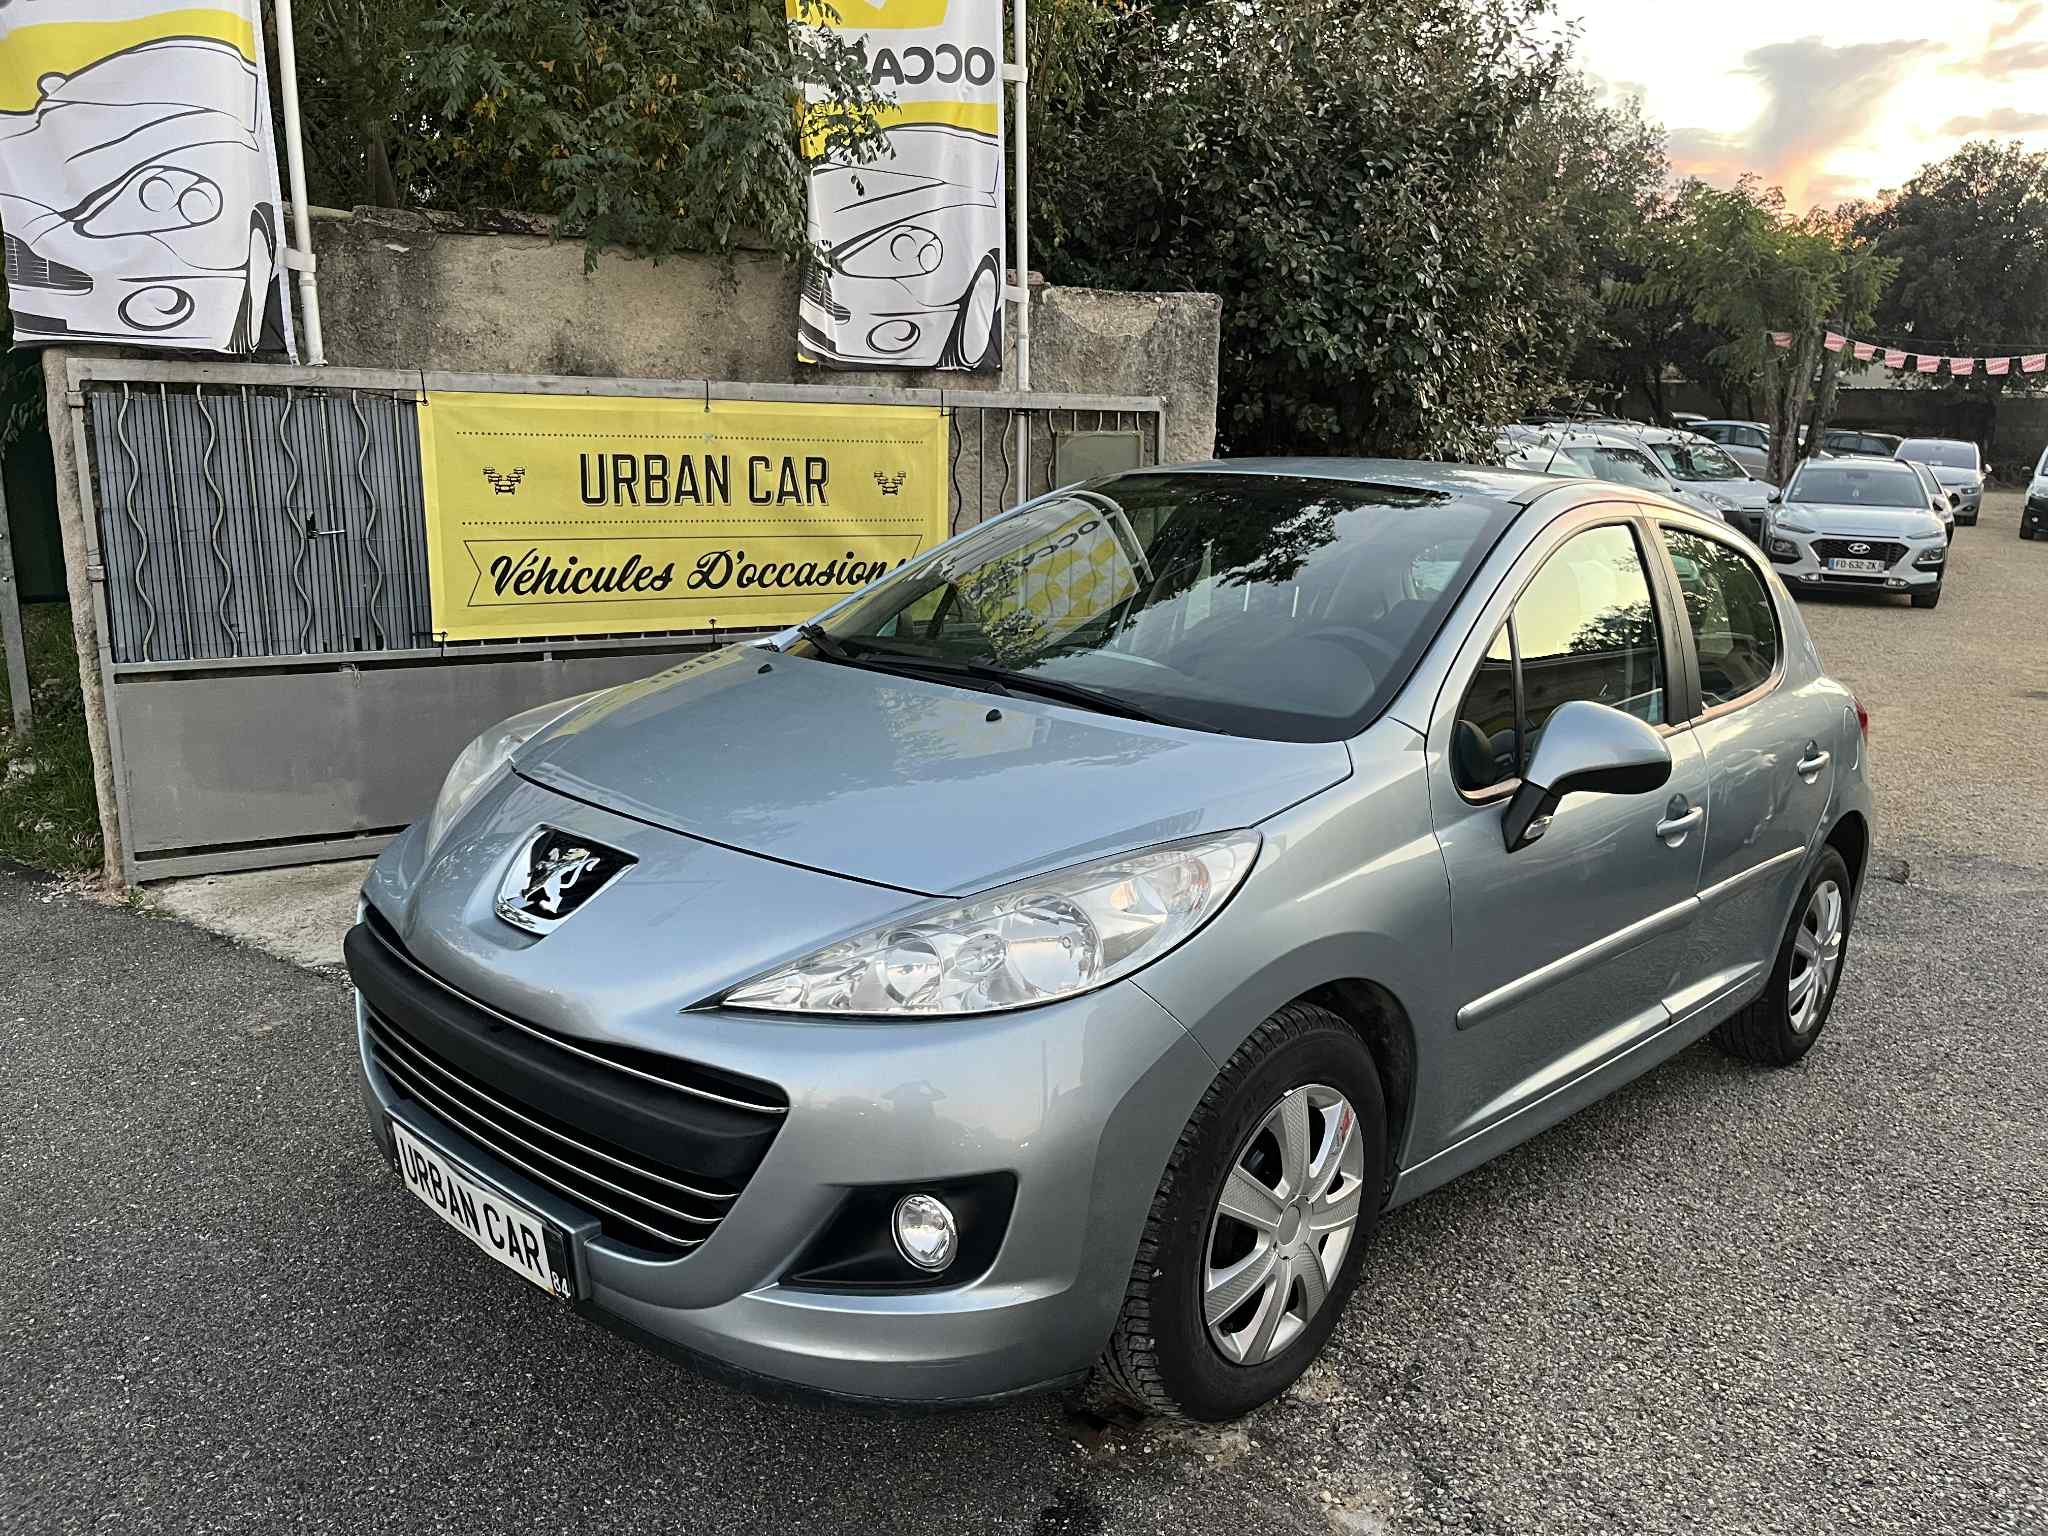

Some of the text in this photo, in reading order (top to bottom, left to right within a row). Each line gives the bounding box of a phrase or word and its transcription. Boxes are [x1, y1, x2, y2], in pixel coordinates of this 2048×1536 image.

[580, 453, 829, 507] URBAN CAR
[490, 548, 906, 596] Véhicules D'occasion
[399, 1137, 545, 1278] URBAN CAR
